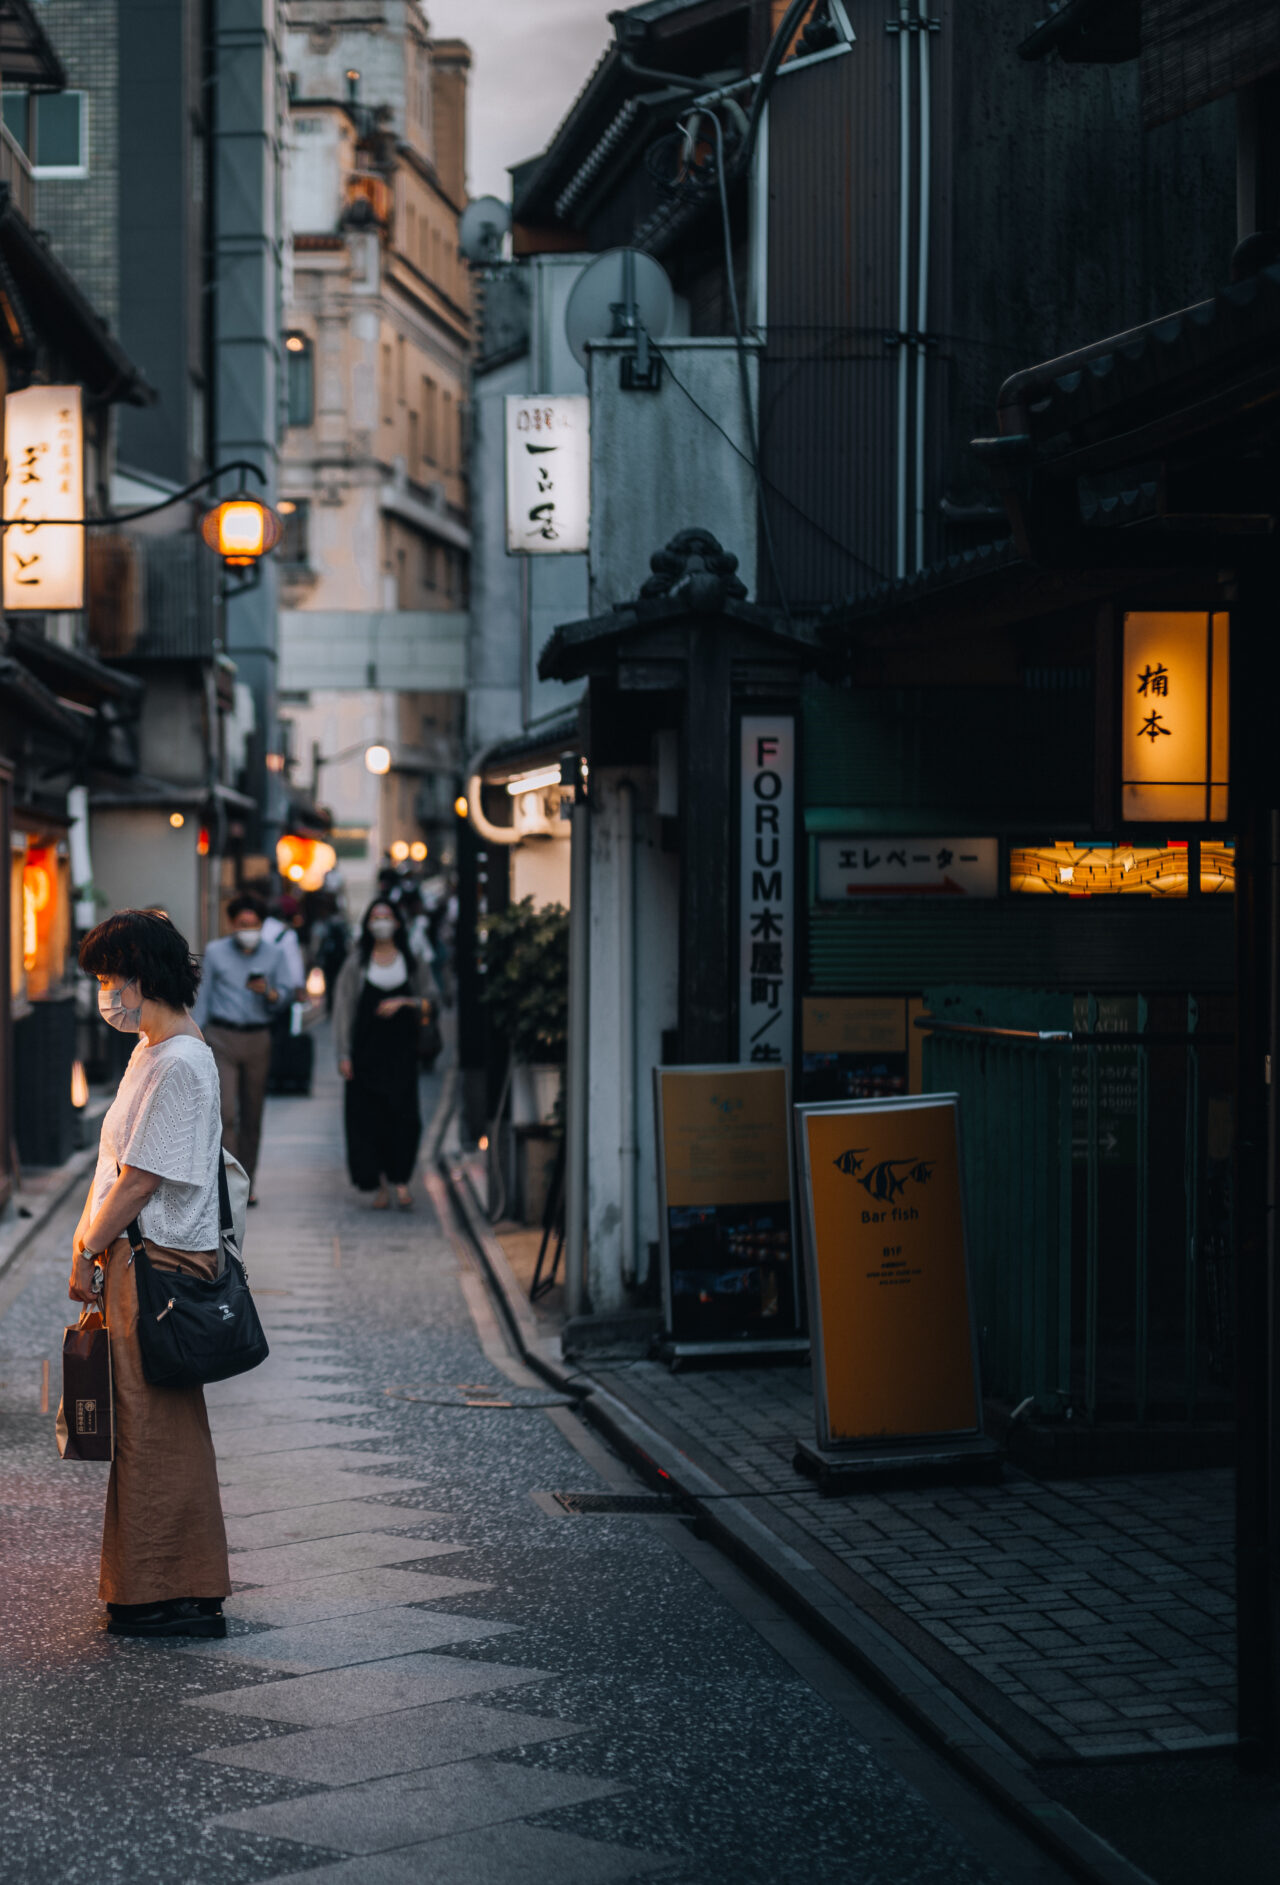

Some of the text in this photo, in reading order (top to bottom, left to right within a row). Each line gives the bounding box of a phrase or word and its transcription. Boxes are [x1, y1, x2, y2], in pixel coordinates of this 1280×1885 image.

[838, 848, 978, 869] エレベーター
[861, 1206, 919, 1224] Bar fish
